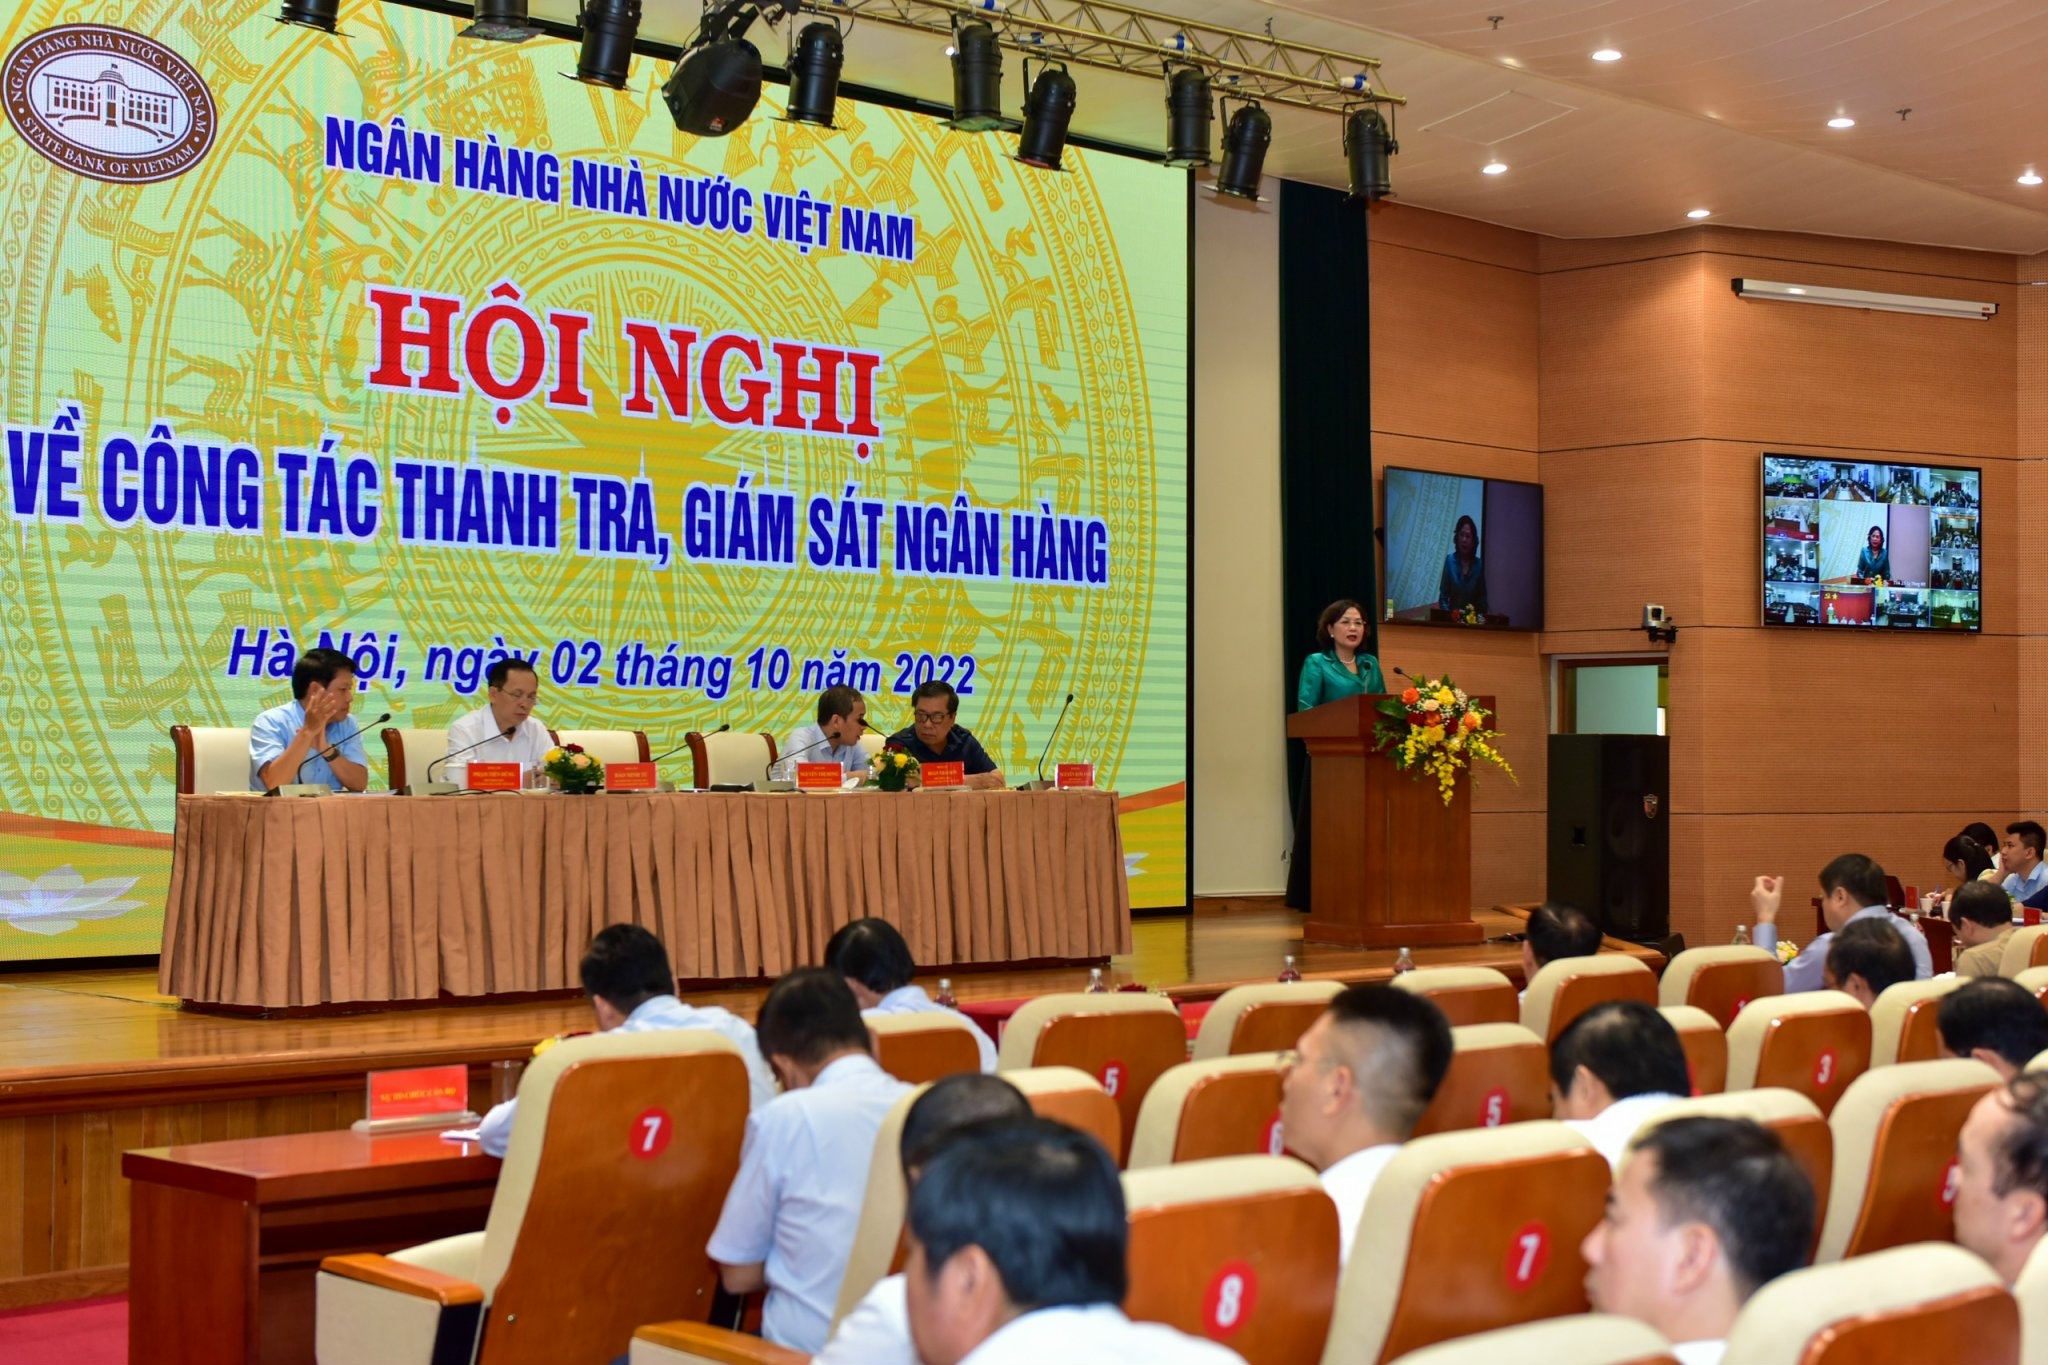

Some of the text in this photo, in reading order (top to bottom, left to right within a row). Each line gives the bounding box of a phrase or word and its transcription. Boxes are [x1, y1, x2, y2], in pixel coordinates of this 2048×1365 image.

[11, 33, 207, 133] NGÂN HÀNG NHÀ NƯỚC VIỆT NAM
[23, 117, 195, 174] STATE BANK OF VIETNAM
[326, 116, 913, 261] NGÂN HÀNG NHÀ NƯỚC VIỆT NAM
[370, 283, 879, 458] HỘI NGHỊ
[8, 406, 1107, 584] VỀ CÔNG TÁC THANH TRA, GIÁM SÁT NGÂN HÀNG
[228, 628, 296, 677] Hà
[552, 640, 602, 684] 02
[616, 642, 733, 699] tháng
[748, 648, 790, 690] 10
[801, 650, 881, 692] năm
[894, 653, 976, 694] 2022
[1105, 1067, 1119, 1097] 5
[1818, 1055, 1832, 1083] 3
[642, 1116, 662, 1152] 7
[1486, 1095, 1502, 1128] 5
[1517, 1233, 1541, 1281] 7
[1216, 1274, 1243, 1328] 8
